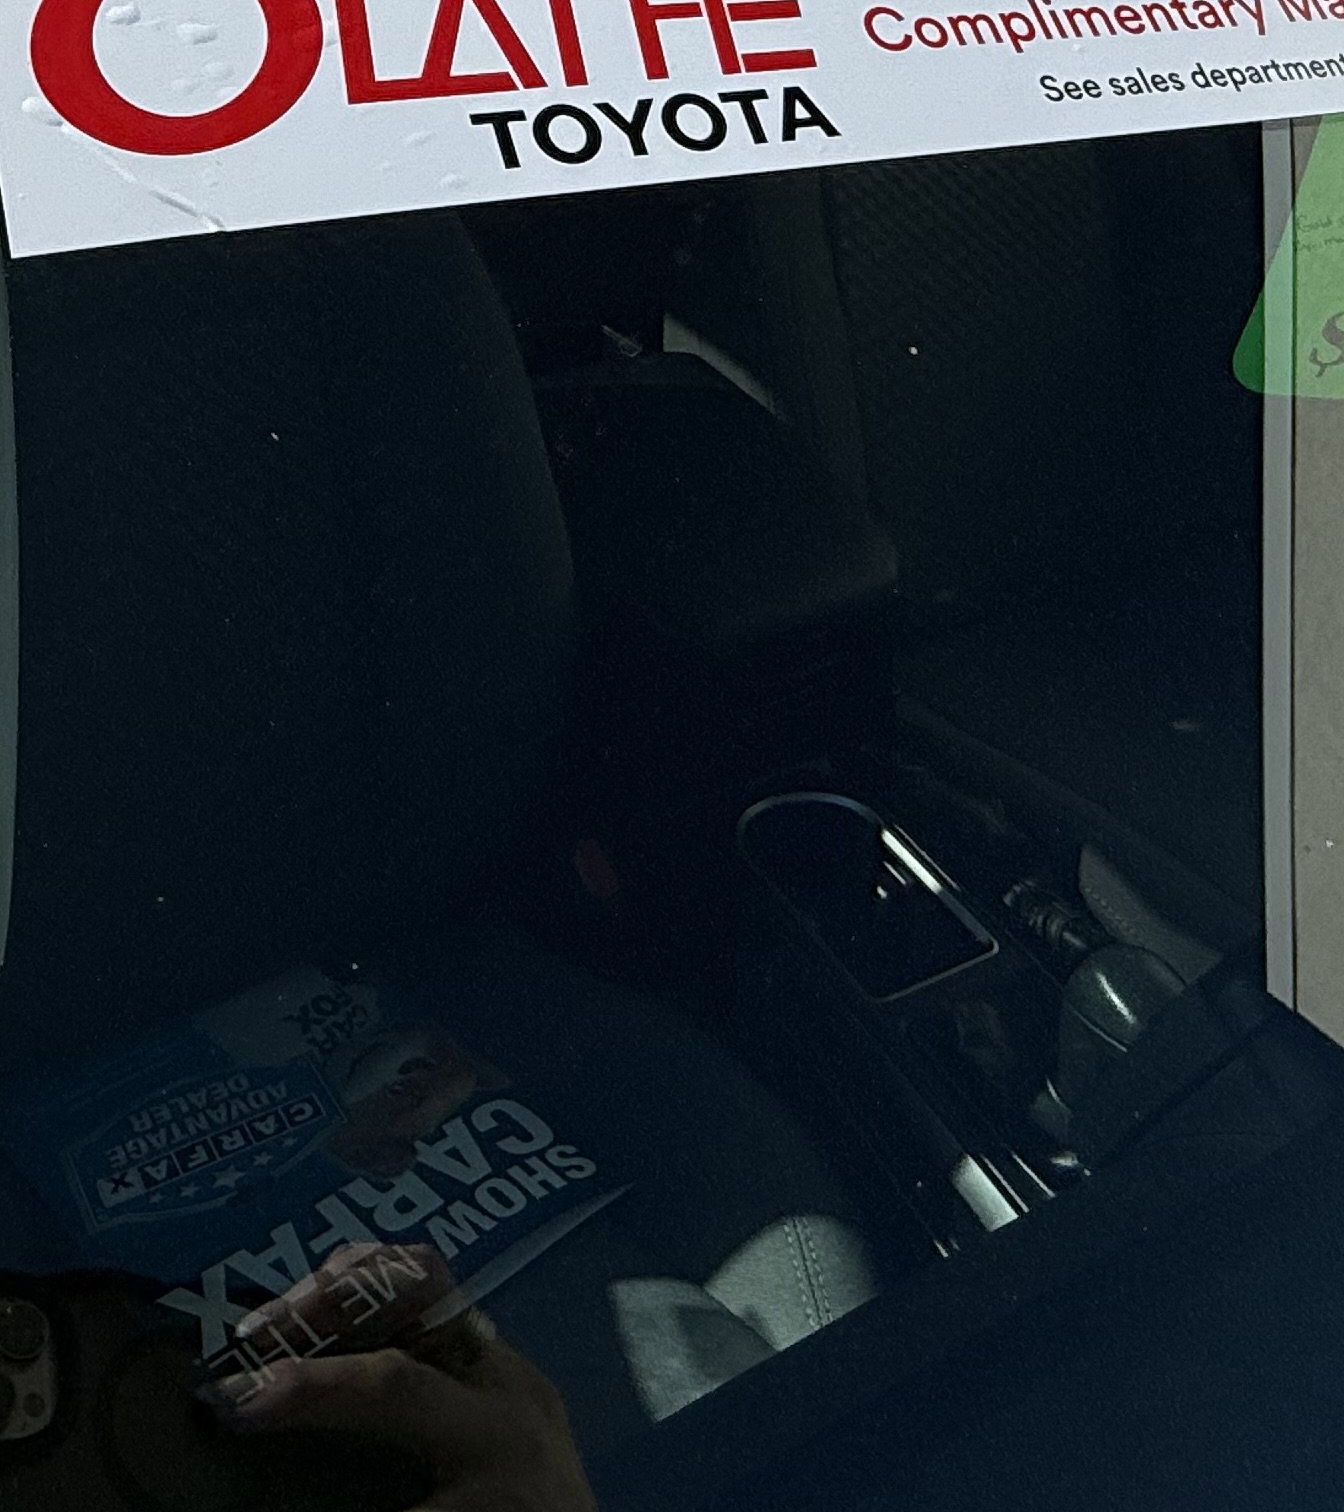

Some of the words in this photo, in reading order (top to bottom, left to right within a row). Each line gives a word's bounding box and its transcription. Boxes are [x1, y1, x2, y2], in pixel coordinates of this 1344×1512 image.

[469, 86, 842, 171] TOYOTA
[1039, 74, 1103, 103] See
[1108, 67, 1186, 96] sales
[106, 1077, 292, 1169] ADVANTAGE
[127, 1071, 253, 1133] DEALER
[103, 1097, 321, 1202] CARFAX
[156, 1098, 555, 1361] CARFAX
[426, 1143, 597, 1259] SHOW
[323, 1242, 430, 1326] ME
[207, 1312, 341, 1406] THE
